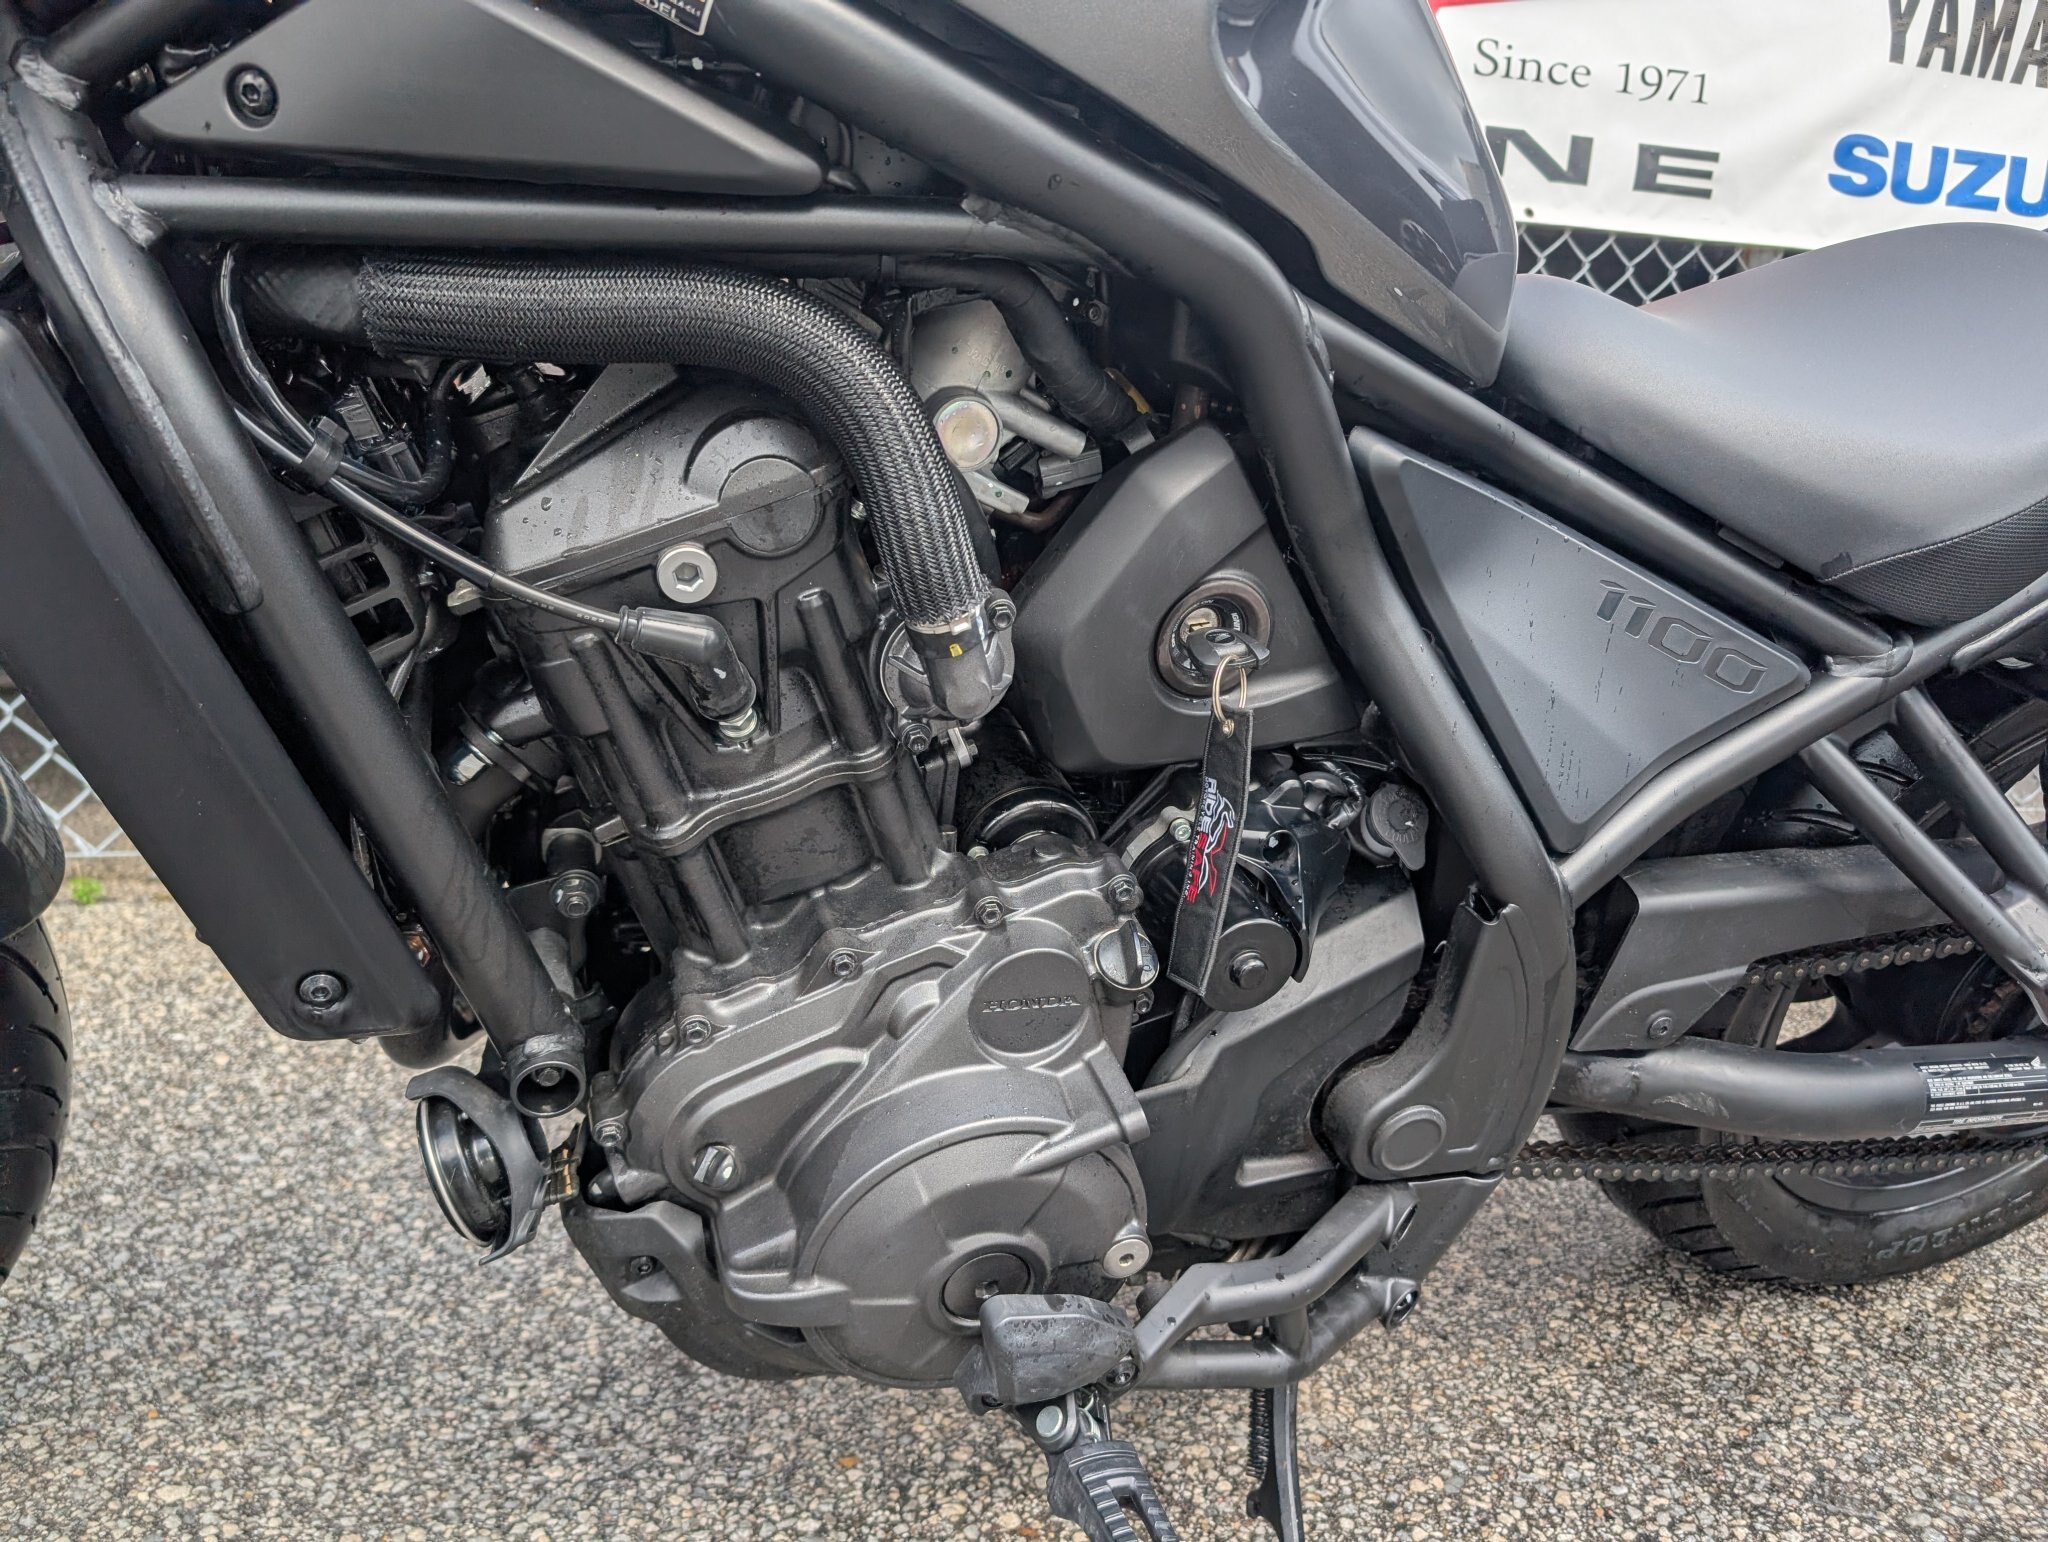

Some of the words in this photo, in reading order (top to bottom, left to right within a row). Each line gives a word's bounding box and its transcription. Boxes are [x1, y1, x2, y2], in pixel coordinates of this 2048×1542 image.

[1473, 38, 1592, 88] Since
[1616, 62, 1710, 104] 1971
[1888, 0, 2048, 89] YAMA
[1828, 133, 2048, 218] SUZU
[1596, 579, 1768, 694] 1100
[982, 996, 1081, 1013] HONDA
